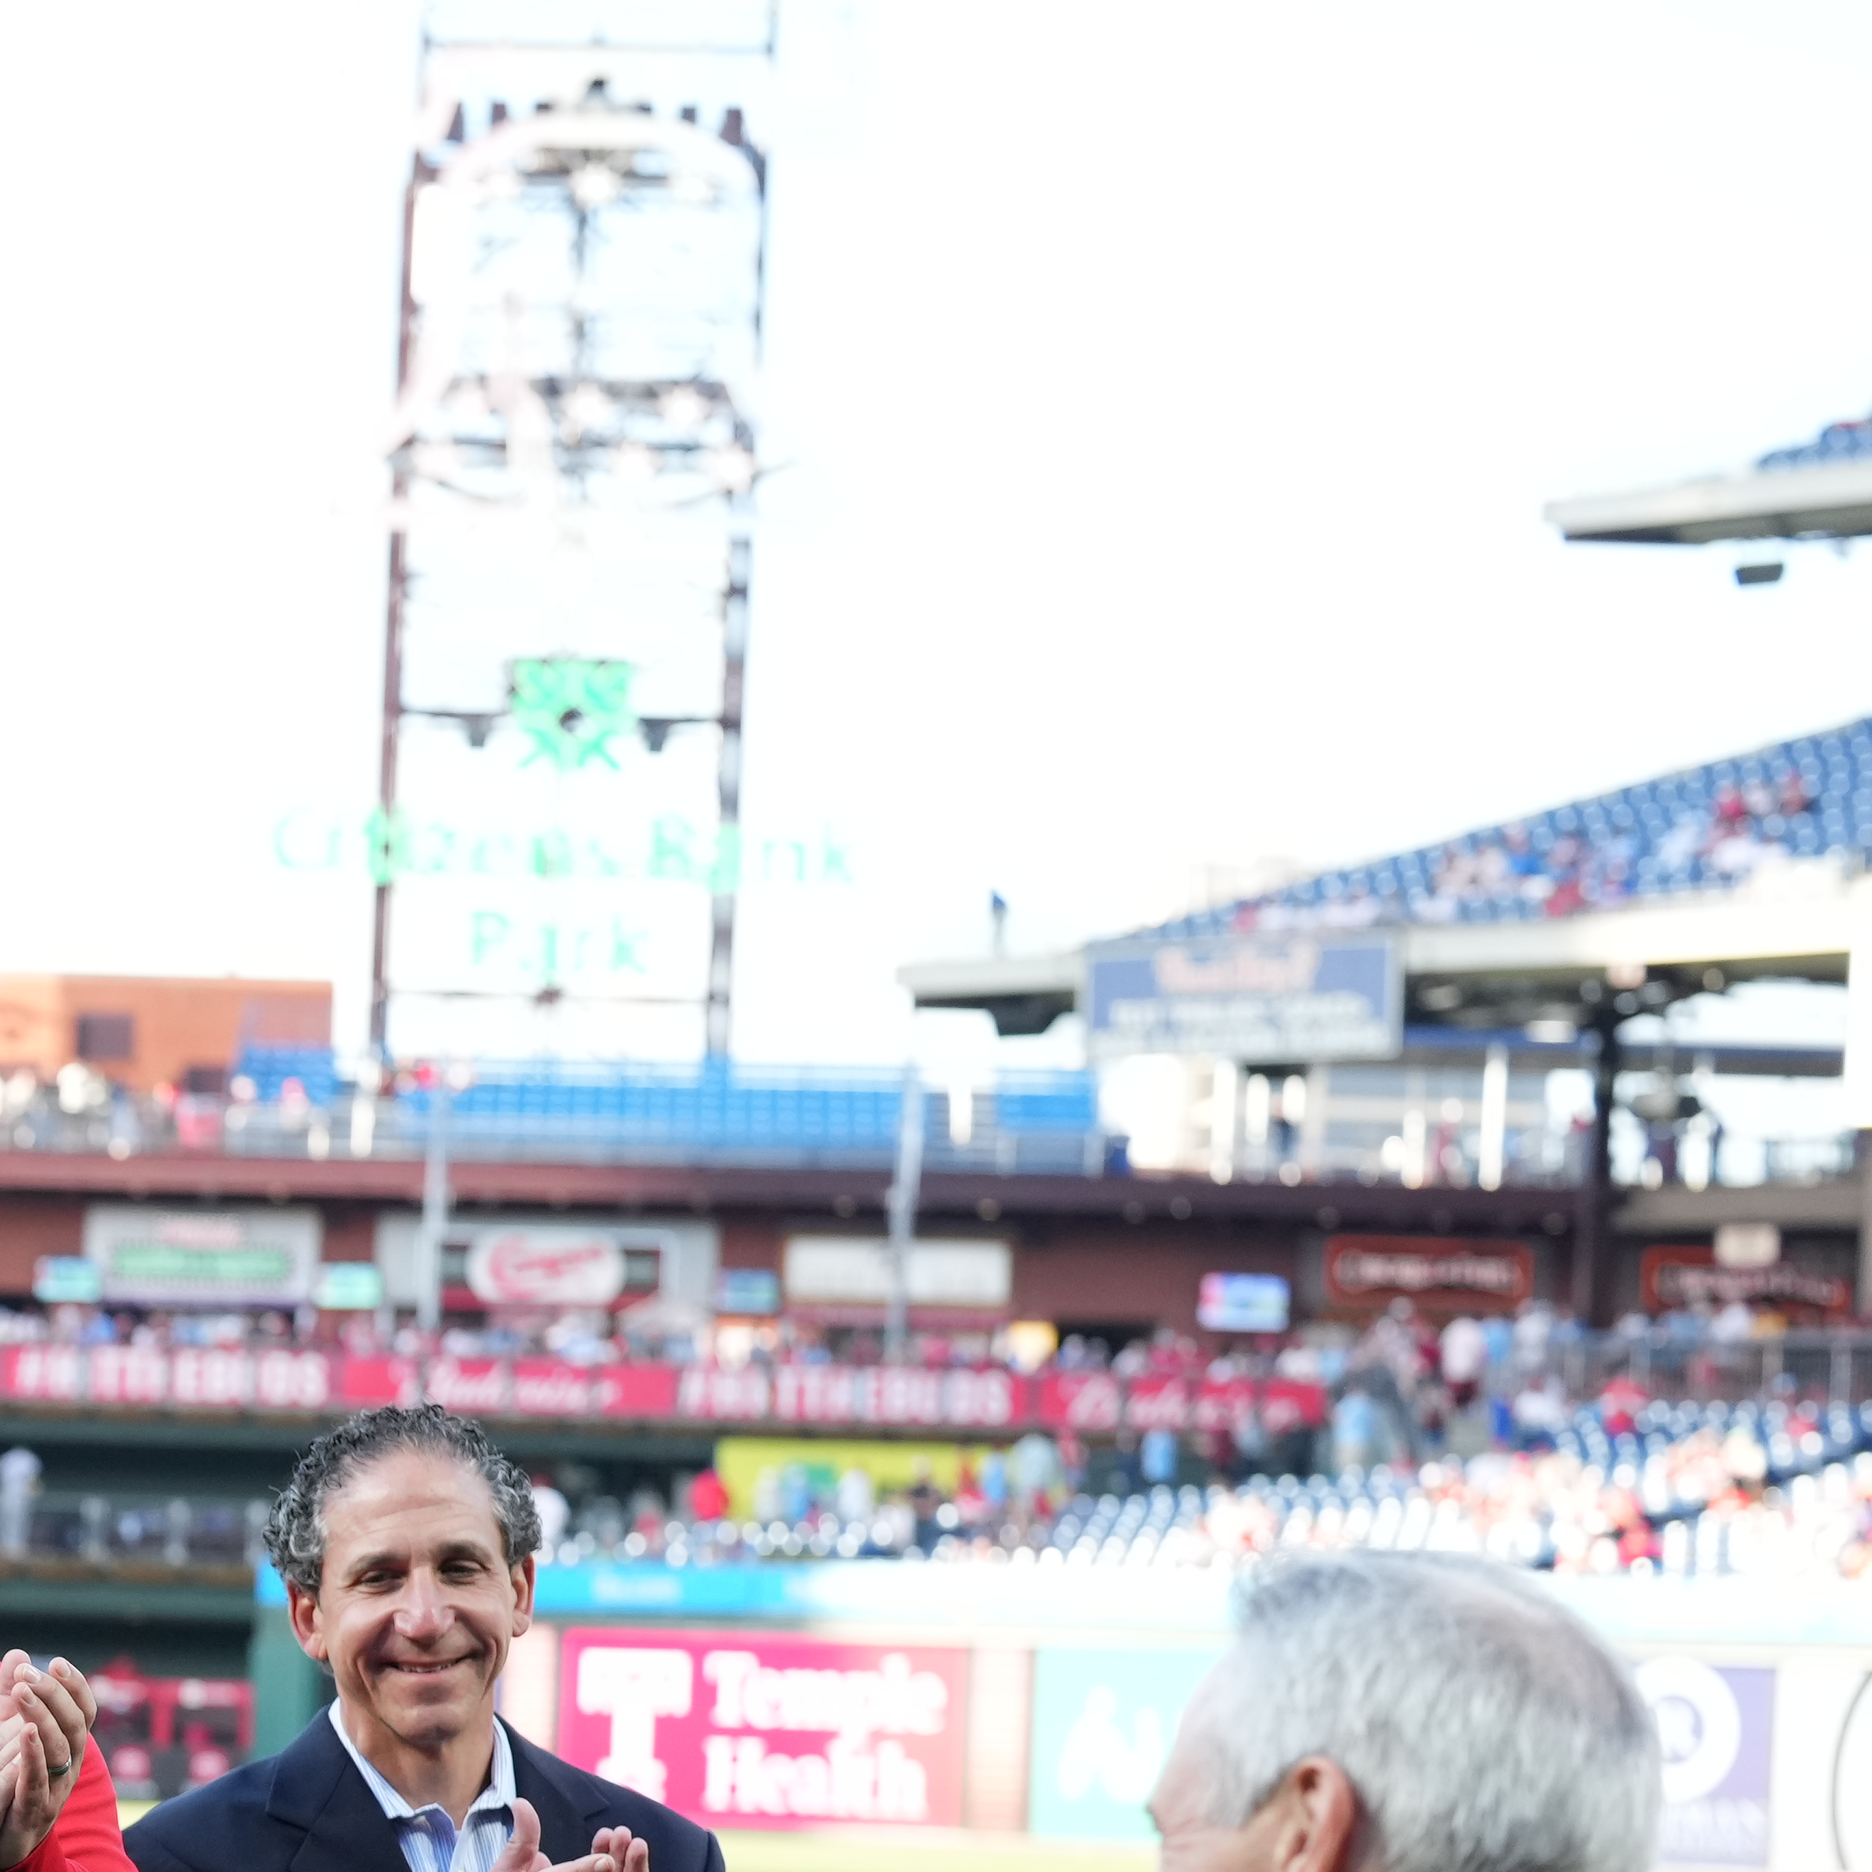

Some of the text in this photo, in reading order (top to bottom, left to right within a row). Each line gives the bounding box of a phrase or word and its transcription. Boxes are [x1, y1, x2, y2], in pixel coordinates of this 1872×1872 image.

[647, 812, 855, 894] Bank
[469, 908, 651, 976] Park
[702, 1649, 949, 1746] Temple
[701, 1733, 929, 1823] Health
